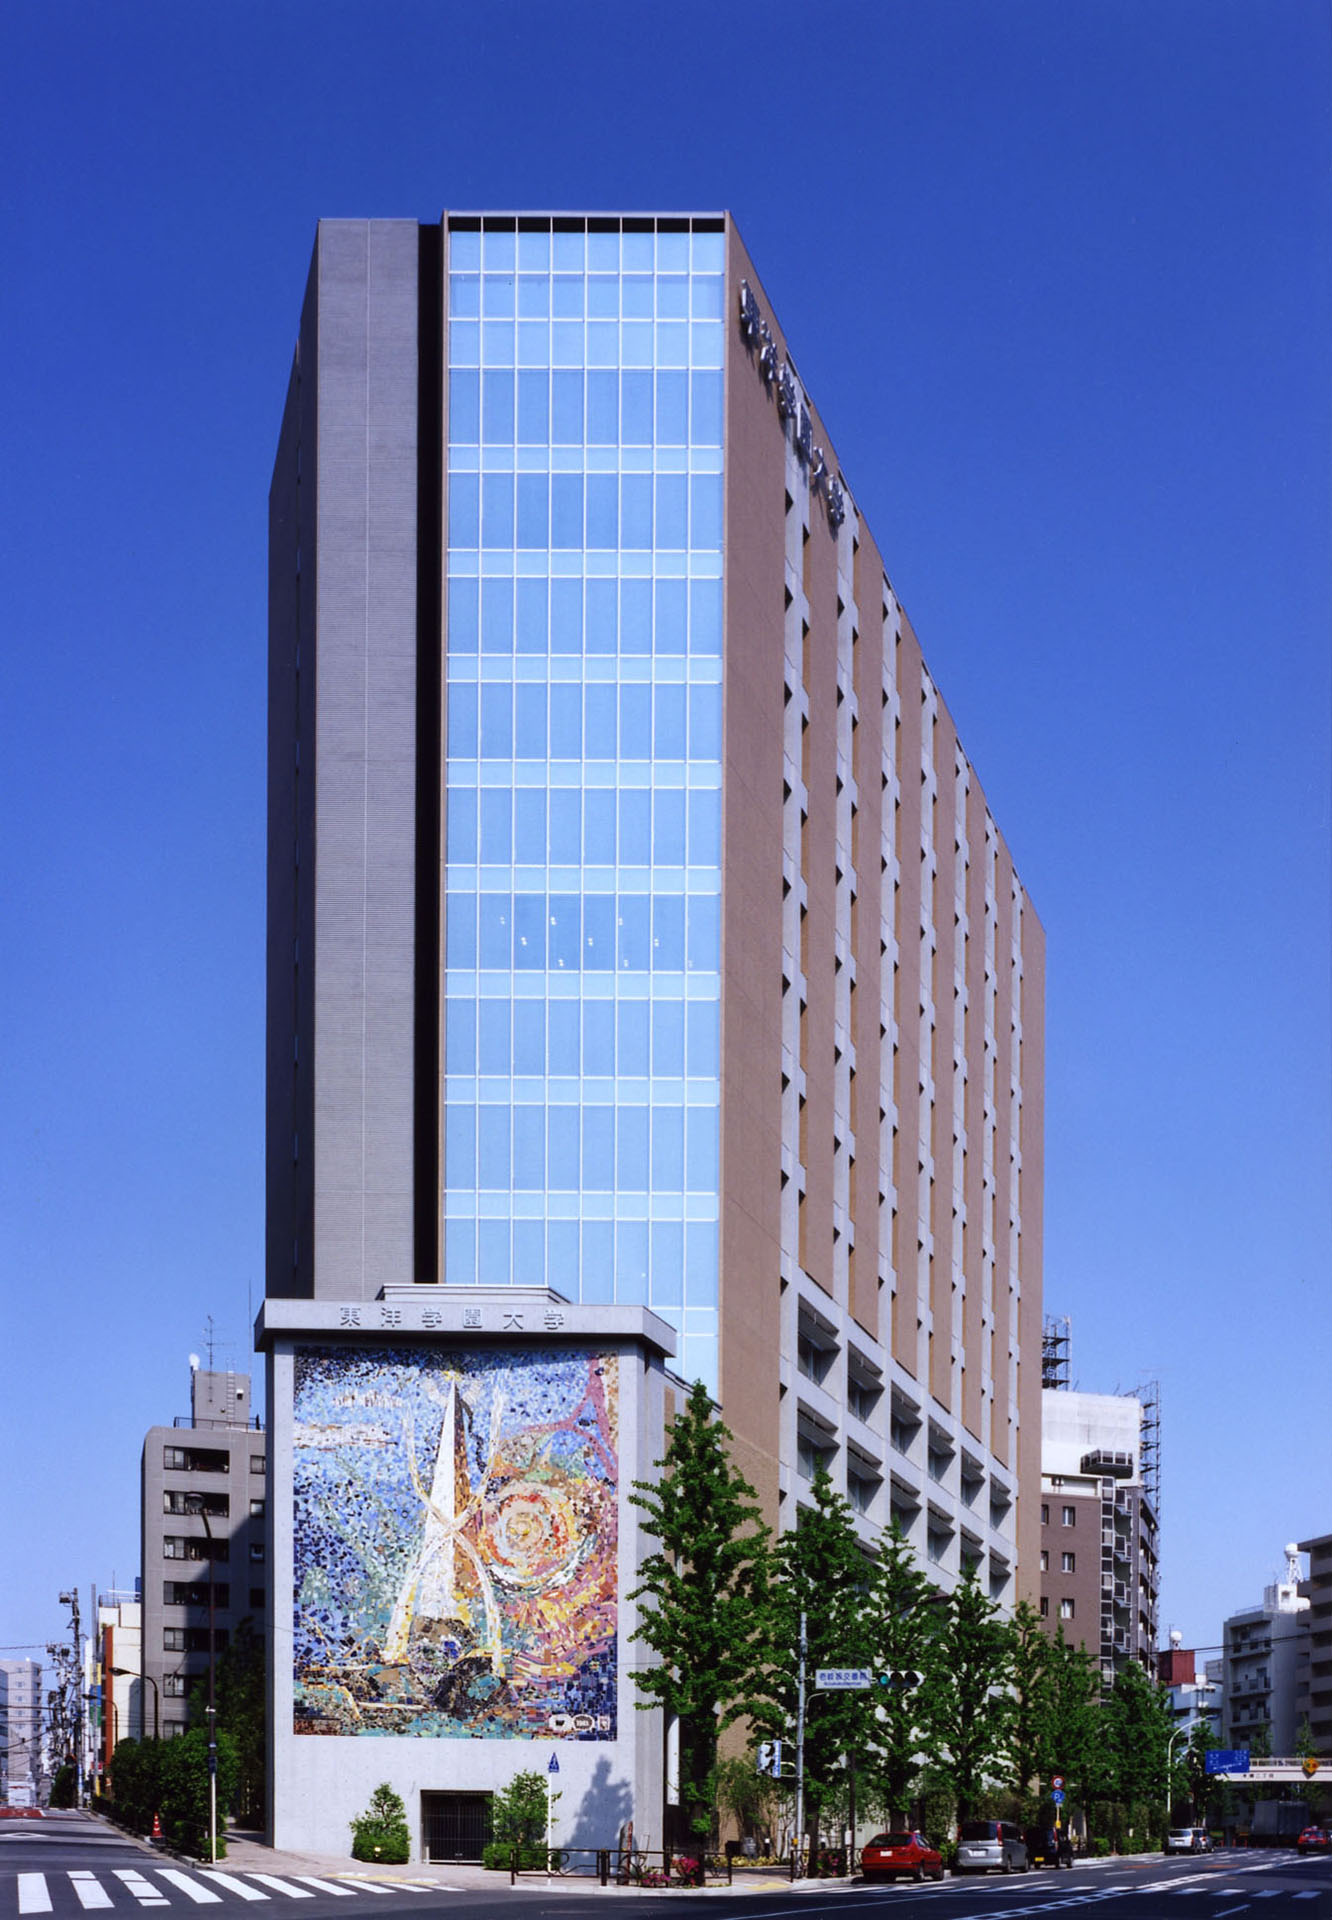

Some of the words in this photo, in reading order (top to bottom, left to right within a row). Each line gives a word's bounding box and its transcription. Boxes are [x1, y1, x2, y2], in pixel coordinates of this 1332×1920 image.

[340, 1307, 565, 1330] 東洋学園大学
